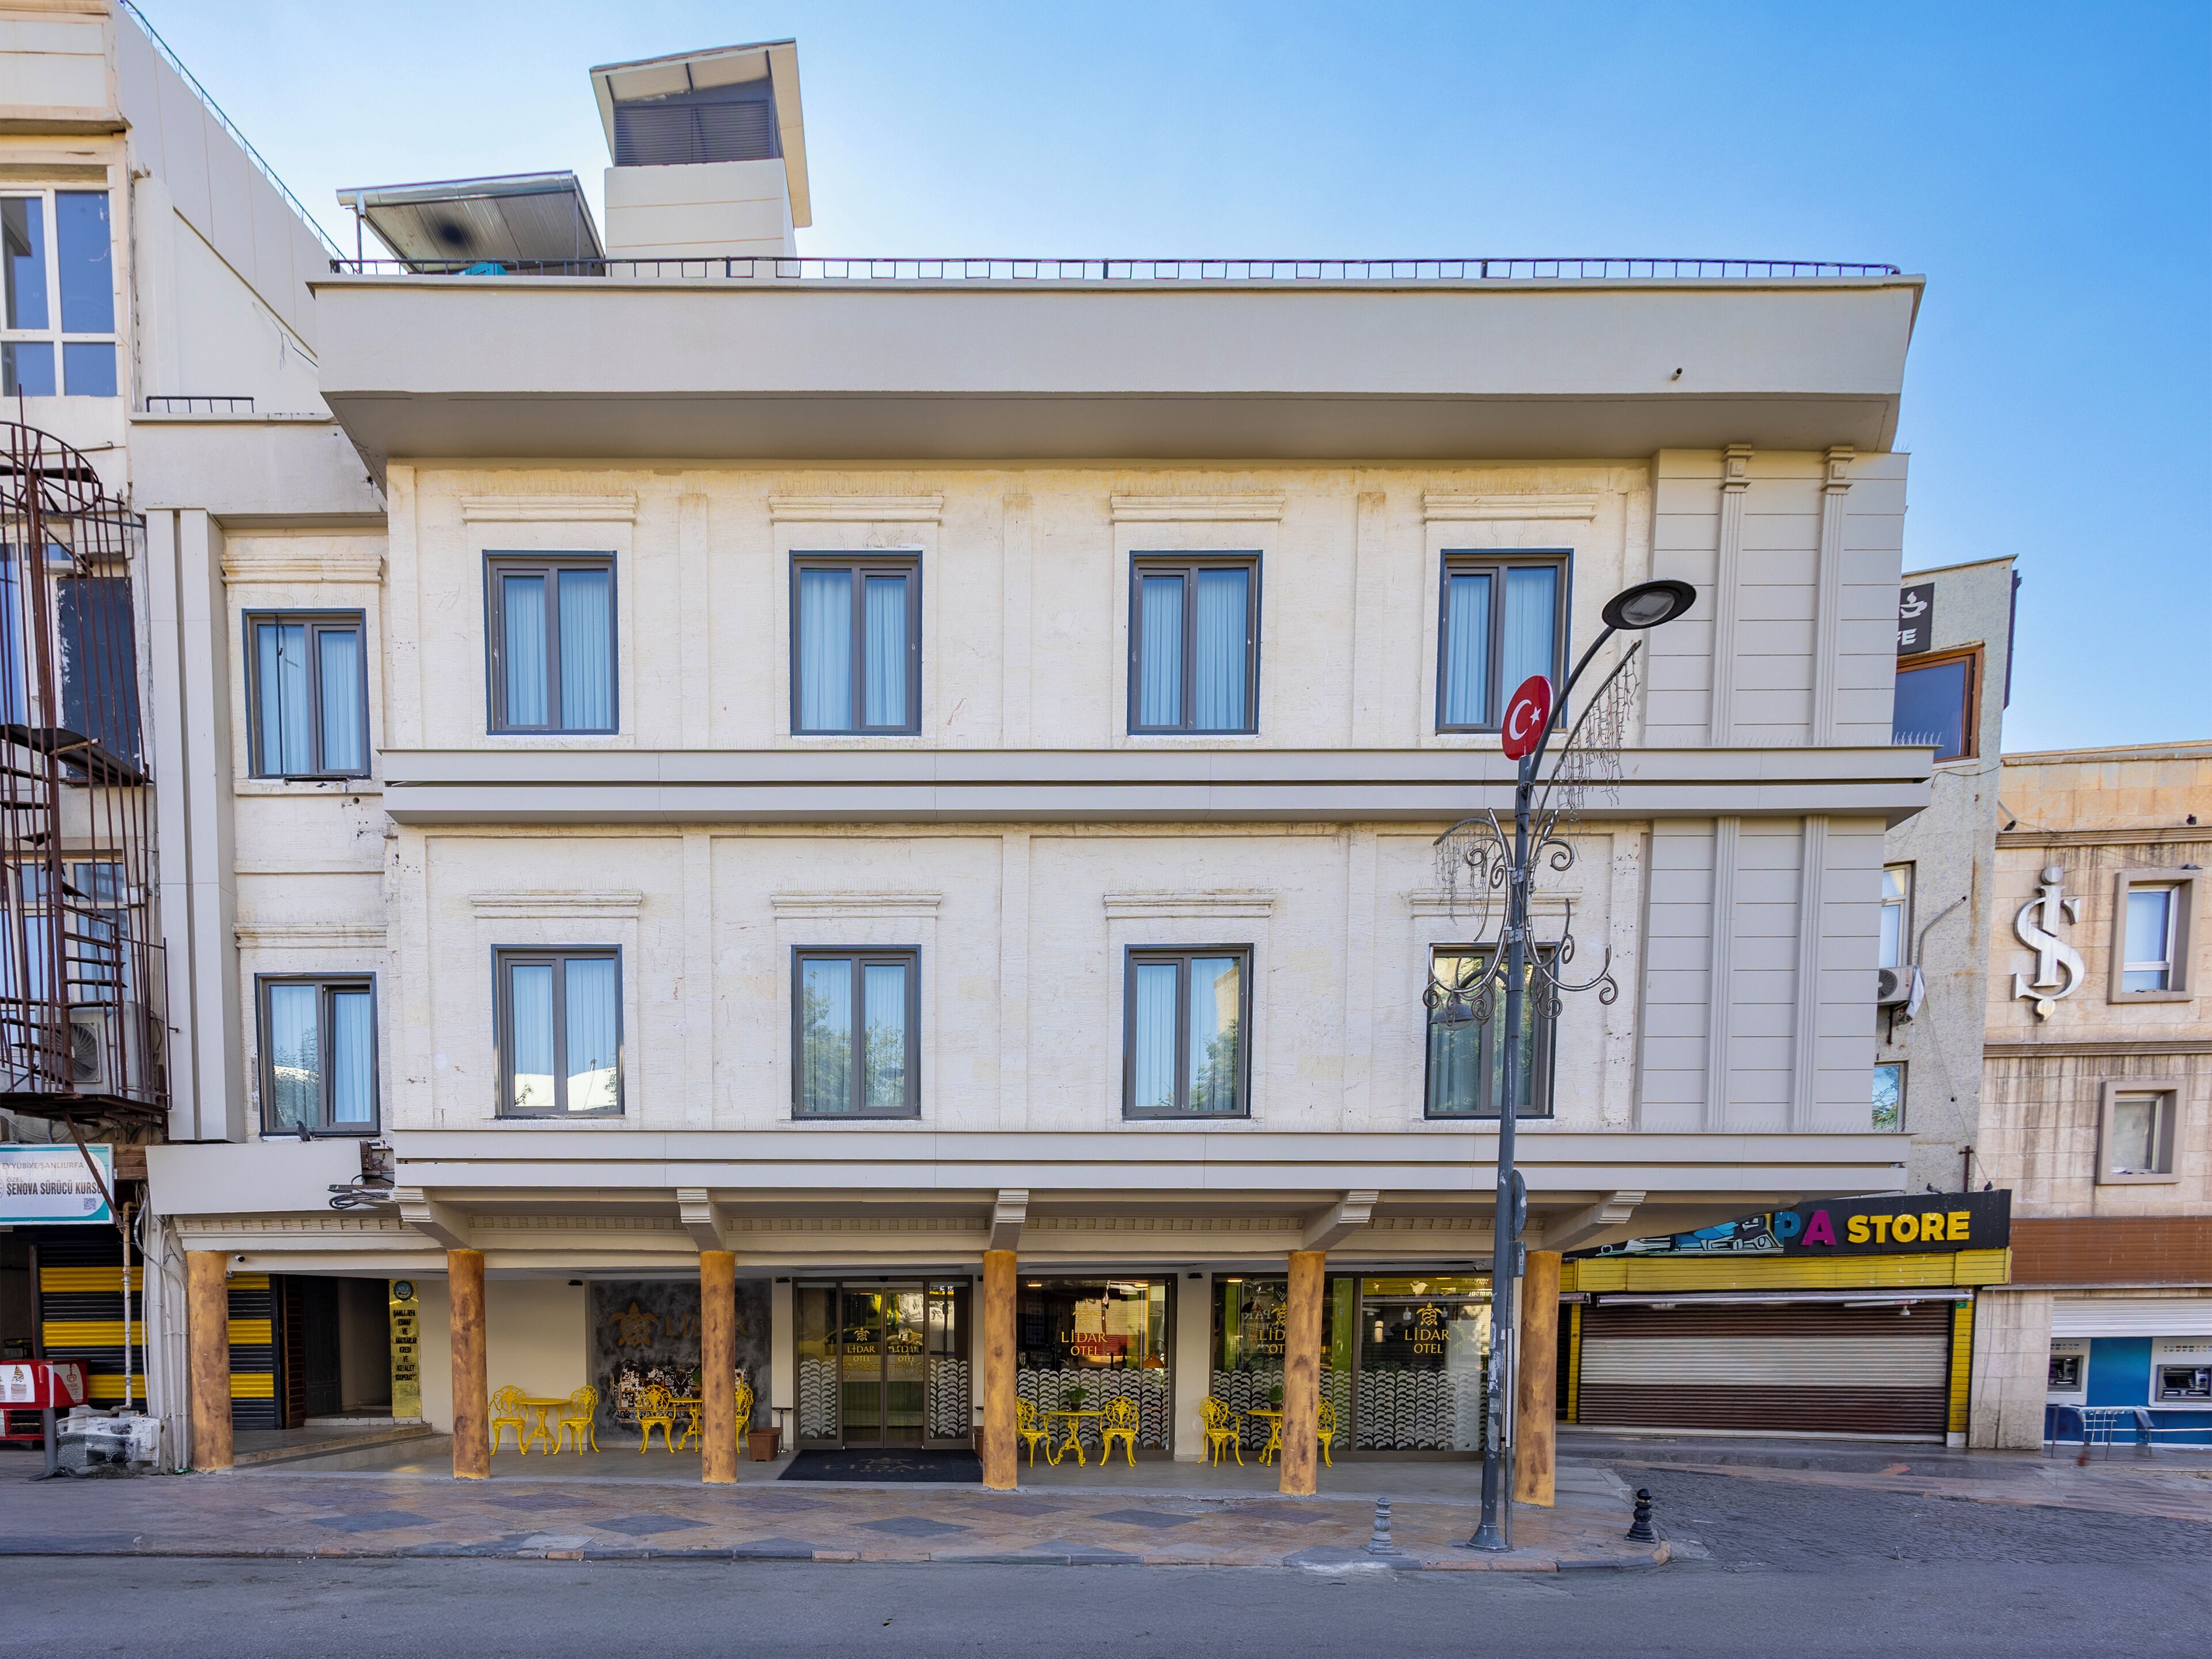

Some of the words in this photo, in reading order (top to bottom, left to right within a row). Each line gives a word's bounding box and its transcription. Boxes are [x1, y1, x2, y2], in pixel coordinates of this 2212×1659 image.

[7, 1183, 38, 1196] ŞENOVA
[40, 1180, 73, 1195] SÜRÜCÜ
[1847, 1211, 1971, 1244] STORE
[1061, 1330, 1108, 1343] LİDAR
[1260, 1327, 1286, 1340] LİD
[1404, 1327, 1451, 1340] LİDAR
[1070, 1346, 1100, 1355] OTEL
[1269, 1344, 1286, 1354] OT
[1414, 1343, 1443, 1354] OTEL
